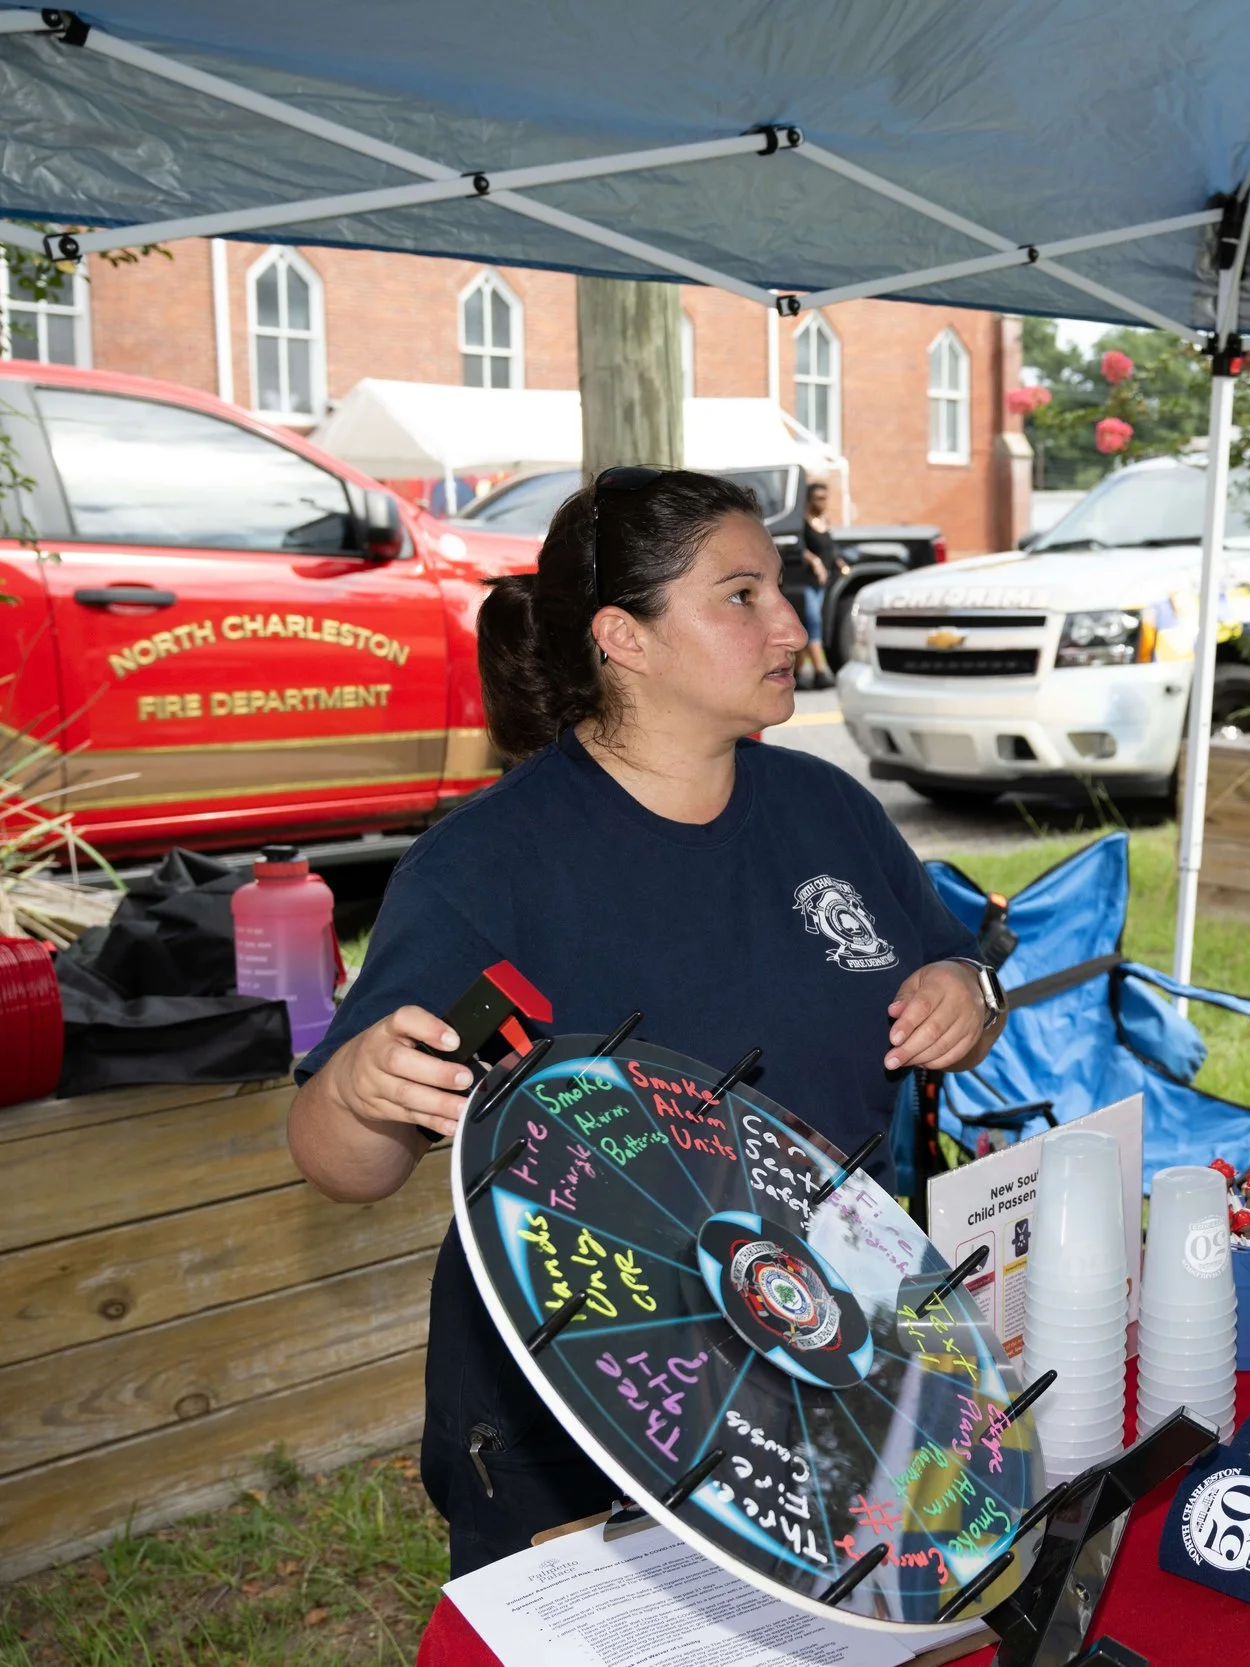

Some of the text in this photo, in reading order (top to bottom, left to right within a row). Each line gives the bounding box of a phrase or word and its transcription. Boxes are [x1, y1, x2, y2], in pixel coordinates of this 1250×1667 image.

[107, 613, 410, 679] NORTH CHARLESTON
[137, 684, 392, 721] FIRE DEPARTMENT
[535, 1075, 612, 1114] Smoke
[628, 1060, 720, 1105] Smoke
[574, 1105, 629, 1135] Alarm
[653, 1093, 726, 1130] Alarm
[600, 1130, 670, 1166] Batteries
[670, 1124, 737, 1161] Units
[742, 1114, 807, 1158] Car
[745, 1138, 821, 1192] Seat
[967, 1188, 1038, 1226] Child Passen
[989, 1181, 1015, 1200] New
[571, 1228, 617, 1317] Only
[614, 1248, 657, 1312] CPR
[925, 1291, 978, 1382] Text
[596, 1351, 681, 1463] Three
[725, 1410, 810, 1483] Causes
[731, 1455, 810, 1520] Fire
[923, 1471, 976, 1516] Alarm
[713, 1480, 828, 1564] Three
[948, 1497, 1012, 1557] Smoke
[1182, 1468, 1242, 1566] NORTH CHARLESTON
[528, 1559, 579, 1581] Palmetto
[538, 1565, 576, 1582] Palace
[509, 1596, 545, 1612] Agreement
[647, 1649, 669, 1658] Waiver
[677, 1638, 700, 1648] Liability
